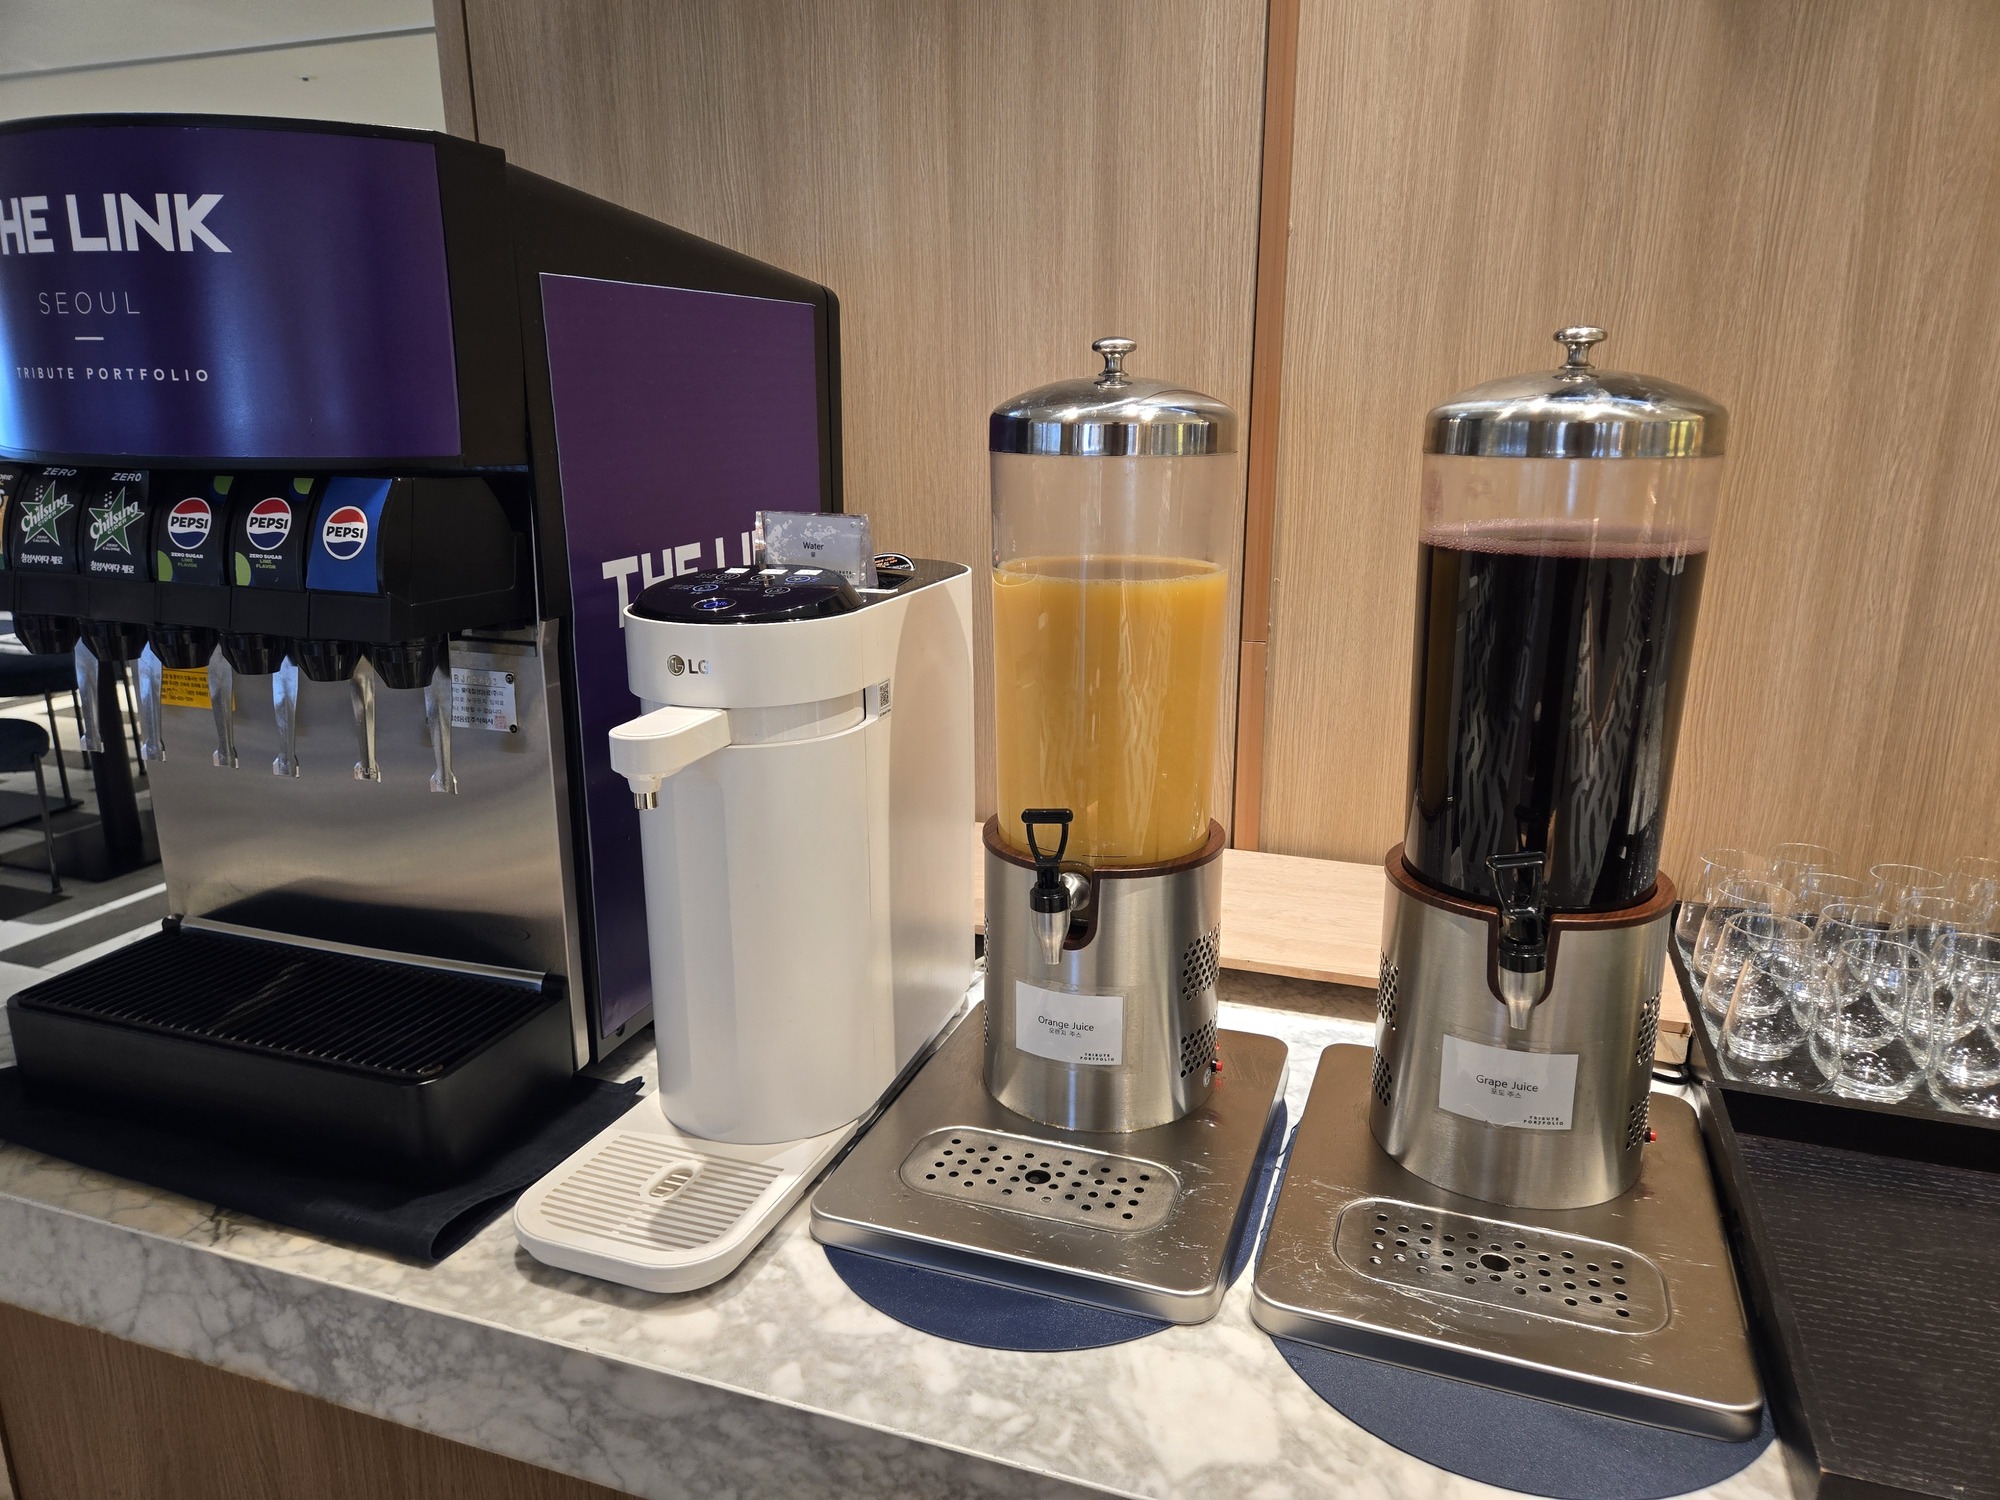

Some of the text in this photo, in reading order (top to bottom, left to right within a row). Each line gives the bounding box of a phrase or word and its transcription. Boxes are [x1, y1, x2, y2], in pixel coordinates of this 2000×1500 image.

[65, 193, 232, 253] LINK
[38, 291, 141, 315] SEOUL
[16, 366, 209, 382] TRIBUTE PORTFOLIO
[42, 467, 77, 477] ZERO
[111, 472, 142, 482] ZERO
[21, 494, 68, 532] Chilsung
[89, 501, 139, 540] Chilsung
[107, 517, 128, 534] CIDER
[170, 516, 209, 530] PEPSI
[249, 516, 289, 530] PEPSI
[326, 526, 364, 539] PEPSI
[802, 541, 825, 551] Water
[687, 658, 709, 675] LG
[1037, 1015, 1095, 1032] Orange Juice
[1048, 1027, 1067, 1036] 오렌지
[1475, 1074, 1539, 1093] Grape Juice
[1490, 1088, 1522, 1099] 포도 주스
